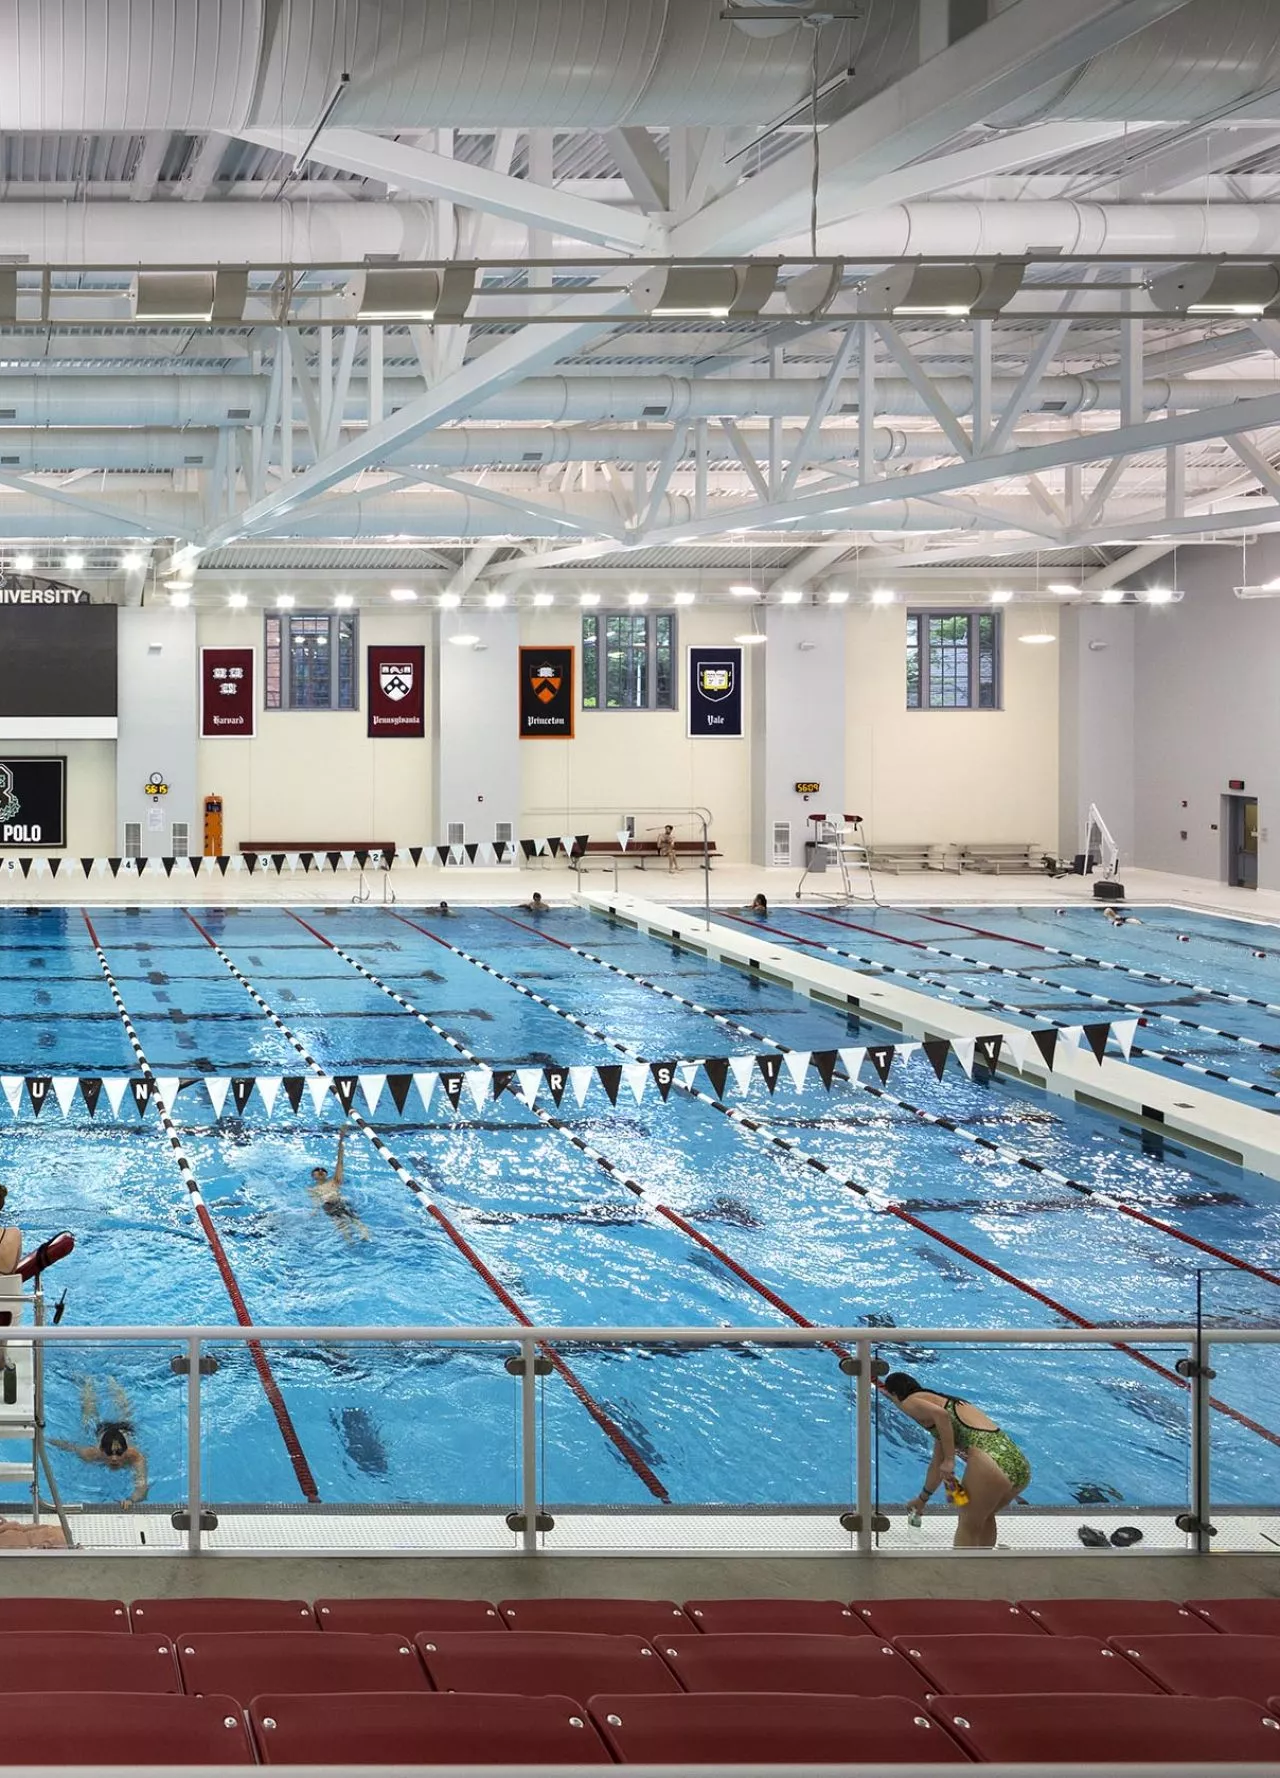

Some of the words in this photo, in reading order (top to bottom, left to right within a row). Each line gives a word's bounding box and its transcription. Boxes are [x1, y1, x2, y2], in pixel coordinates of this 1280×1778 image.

[213, 715, 244, 726] Harvard
[373, 715, 420, 726] Pennsylvania
[527, 715, 565, 726] Princeton
[707, 715, 725, 726] Yale
[3, 824, 41, 842] POLO
[8, 861, 14, 869] 5
[262, 858, 268, 866] 3
